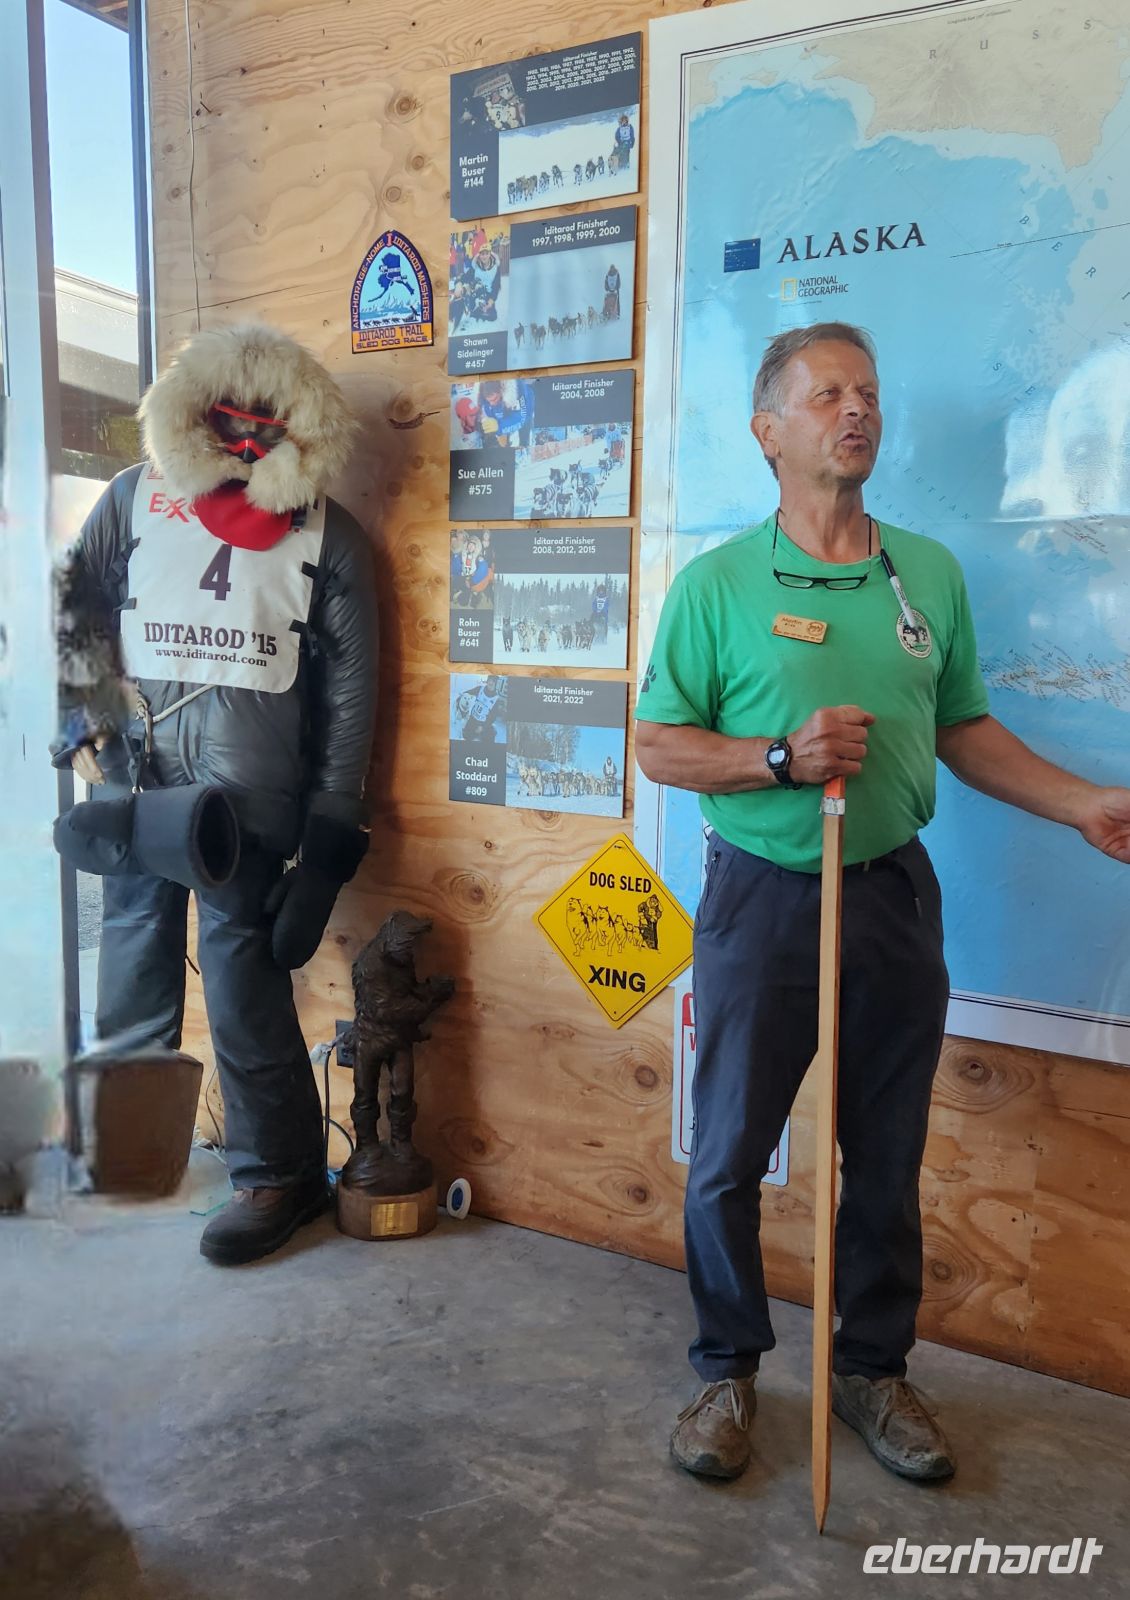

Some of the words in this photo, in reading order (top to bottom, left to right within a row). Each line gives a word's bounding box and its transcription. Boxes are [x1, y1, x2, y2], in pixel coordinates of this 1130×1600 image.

[459, 153, 489, 167] Martin
[462, 167, 486, 178] Buser
[464, 175, 484, 188] #144
[545, 222, 576, 235] Iditarod
[576, 219, 608, 231] Finisher
[532, 236, 552, 247] 1997,
[554, 232, 574, 244] 1998,
[576, 230, 597, 240] 1999,
[598, 226, 620, 237] 2000
[777, 222, 926, 264] ALASKA
[394, 235, 421, 276] IDITAROD
[417, 271, 430, 321] MUSHERS
[799, 275, 838, 288] NATIONAL
[798, 283, 849, 298] GEOGRAPHIC
[360, 327, 396, 342] IDITAROD
[399, 324, 424, 337] TRAIL
[356, 340, 378, 350] SLED
[382, 338, 400, 346] DOG
[404, 336, 428, 344] RACE
[463, 338, 488, 346] Shawn
[457, 348, 494, 359] Sidelinger
[465, 360, 486, 368] #457
[552, 380, 582, 391] Iditarod
[584, 378, 614, 388] Finisher
[560, 390, 582, 400] 2004,
[584, 388, 605, 398] 2008
[458, 468, 476, 480] Sue
[478, 467, 504, 478] Allen
[468, 484, 492, 495] #575
[534, 536, 564, 544] Iditarod
[566, 536, 596, 544] Finisher
[532, 546, 554, 554] 2008,
[556, 546, 576, 555] 2012,
[578, 546, 596, 554] 2015
[199, 543, 232, 601] 4
[459, 617, 480, 626] Rohn
[144, 622, 245, 650] IDITAROD
[252, 632, 277, 656] '15
[458, 628, 480, 637] Buser
[460, 638, 479, 647] #641
[155, 649, 268, 667] www.iditarod.com
[534, 685, 563, 694] Iditarod
[564, 686, 594, 696] Finisher
[543, 694, 562, 704] 2021,
[564, 696, 584, 705] 2022
[466, 756, 488, 768] Chad
[456, 770, 497, 783] Stoddard
[466, 786, 488, 796] #809
[589, 871, 615, 895] DOG
[620, 875, 652, 900] SLED
[588, 964, 646, 994] XING
